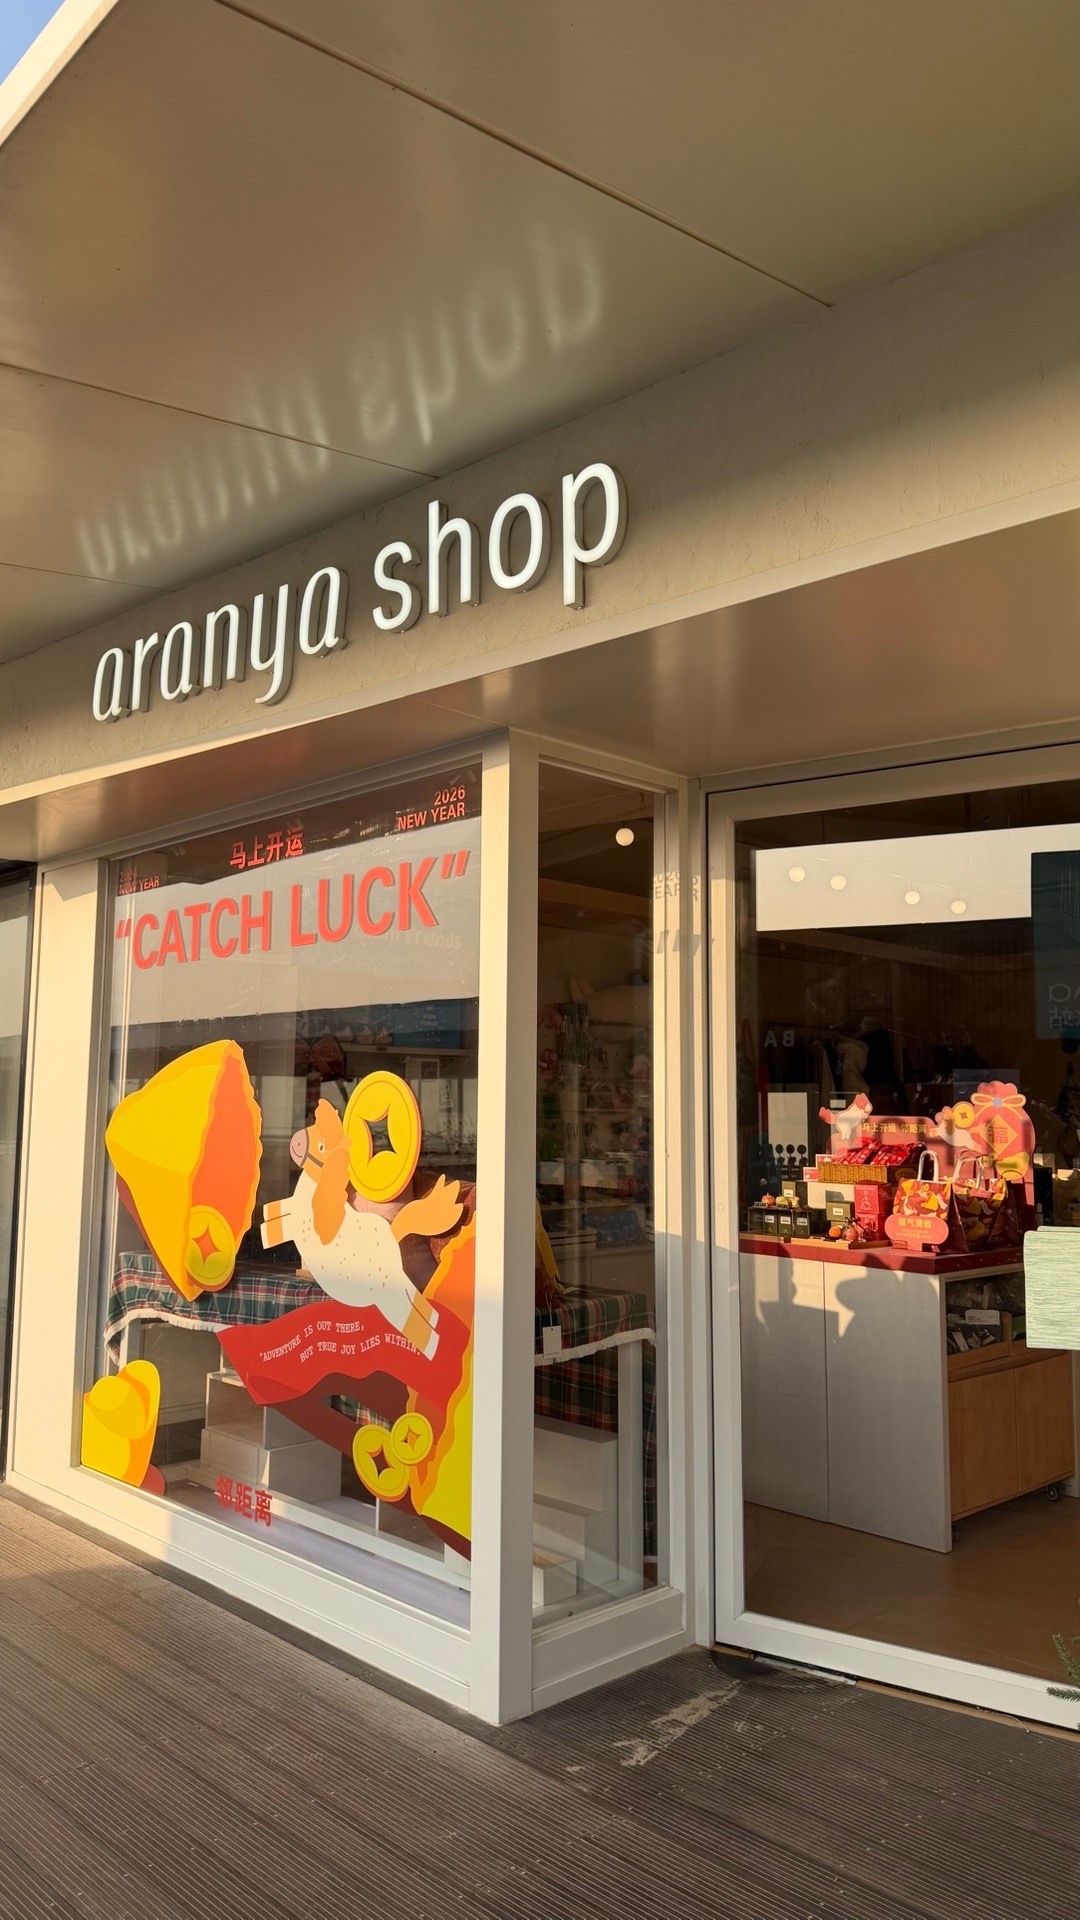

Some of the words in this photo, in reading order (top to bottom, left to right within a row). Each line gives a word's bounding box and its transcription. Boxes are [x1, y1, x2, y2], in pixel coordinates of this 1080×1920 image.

[92, 566, 345, 705] aranya
[373, 463, 624, 631] shop
[434, 785, 466, 806] 2026
[397, 811, 427, 831] NEW
[431, 802, 466, 824] YEAR
[229, 825, 305, 870] 马上开运
[138, 876, 160, 892] YEAR
[862, 1122, 897, 1134] 马上开运
[987, 1126, 1009, 1144] 福
[304, 1325, 314, 1338] IS
[317, 1321, 332, 1331] OUT
[300, 1347, 314, 1363] BUT
[317, 1342, 337, 1353] TRUE
[341, 1344, 356, 1355] JOY
[360, 1335, 381, 1353] LIES
[214, 1474, 273, 1527] 邻距离
